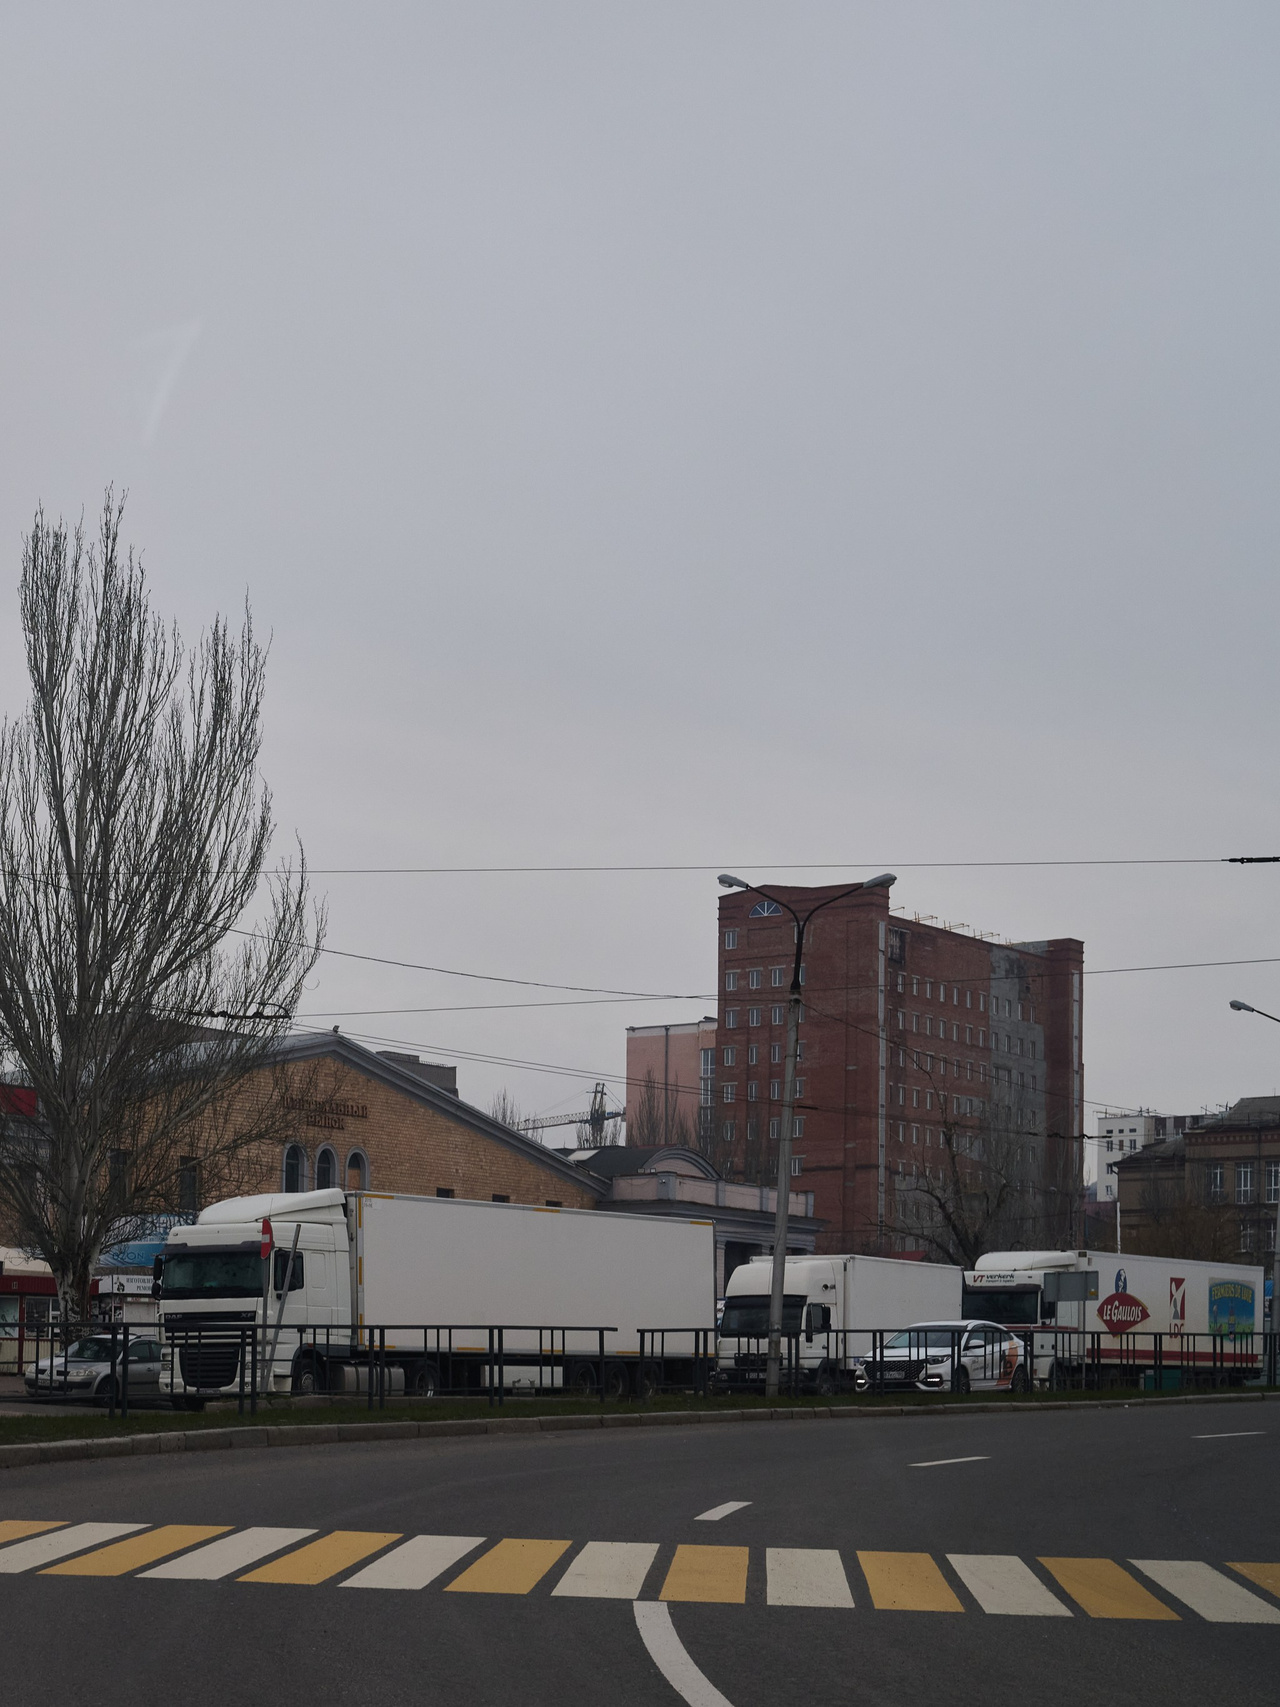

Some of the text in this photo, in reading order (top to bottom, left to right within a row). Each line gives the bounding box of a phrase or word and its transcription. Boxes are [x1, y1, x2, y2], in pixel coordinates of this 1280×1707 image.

[973, 1274, 986, 1283] VT
[1103, 1300, 1142, 1323] LE GAULOIS
[1169, 1322, 1185, 1339] LDC
